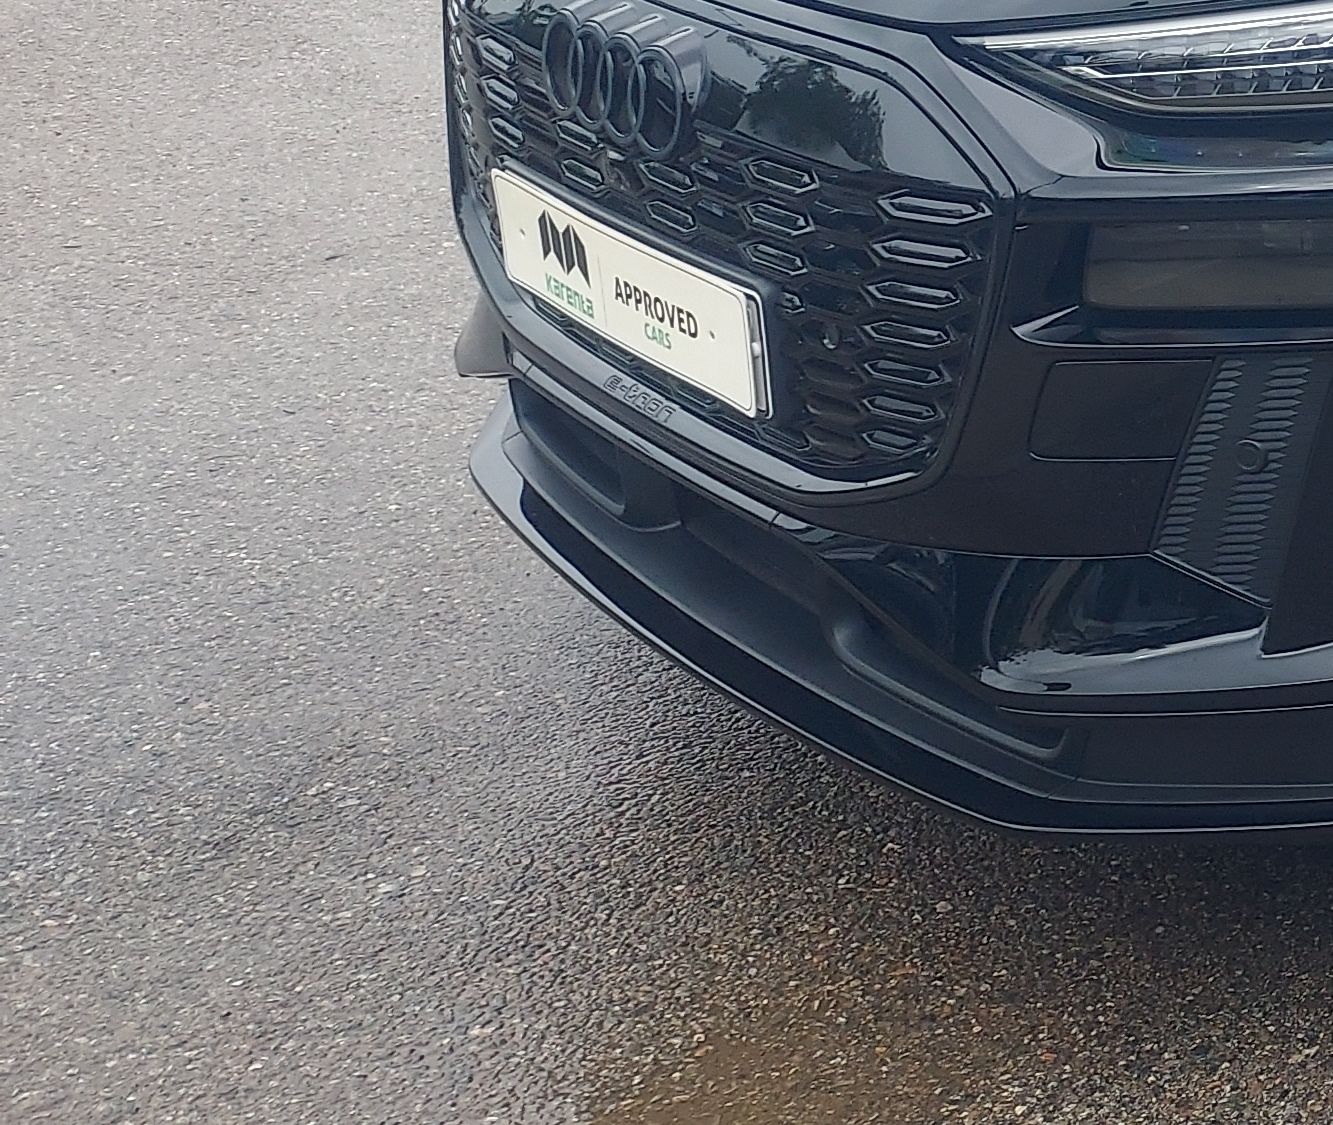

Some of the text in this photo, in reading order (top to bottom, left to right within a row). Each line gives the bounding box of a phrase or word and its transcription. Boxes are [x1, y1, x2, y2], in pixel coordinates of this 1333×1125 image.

[545, 273, 698, 339] karenta APPROVED
[644, 322, 672, 350] CARS
